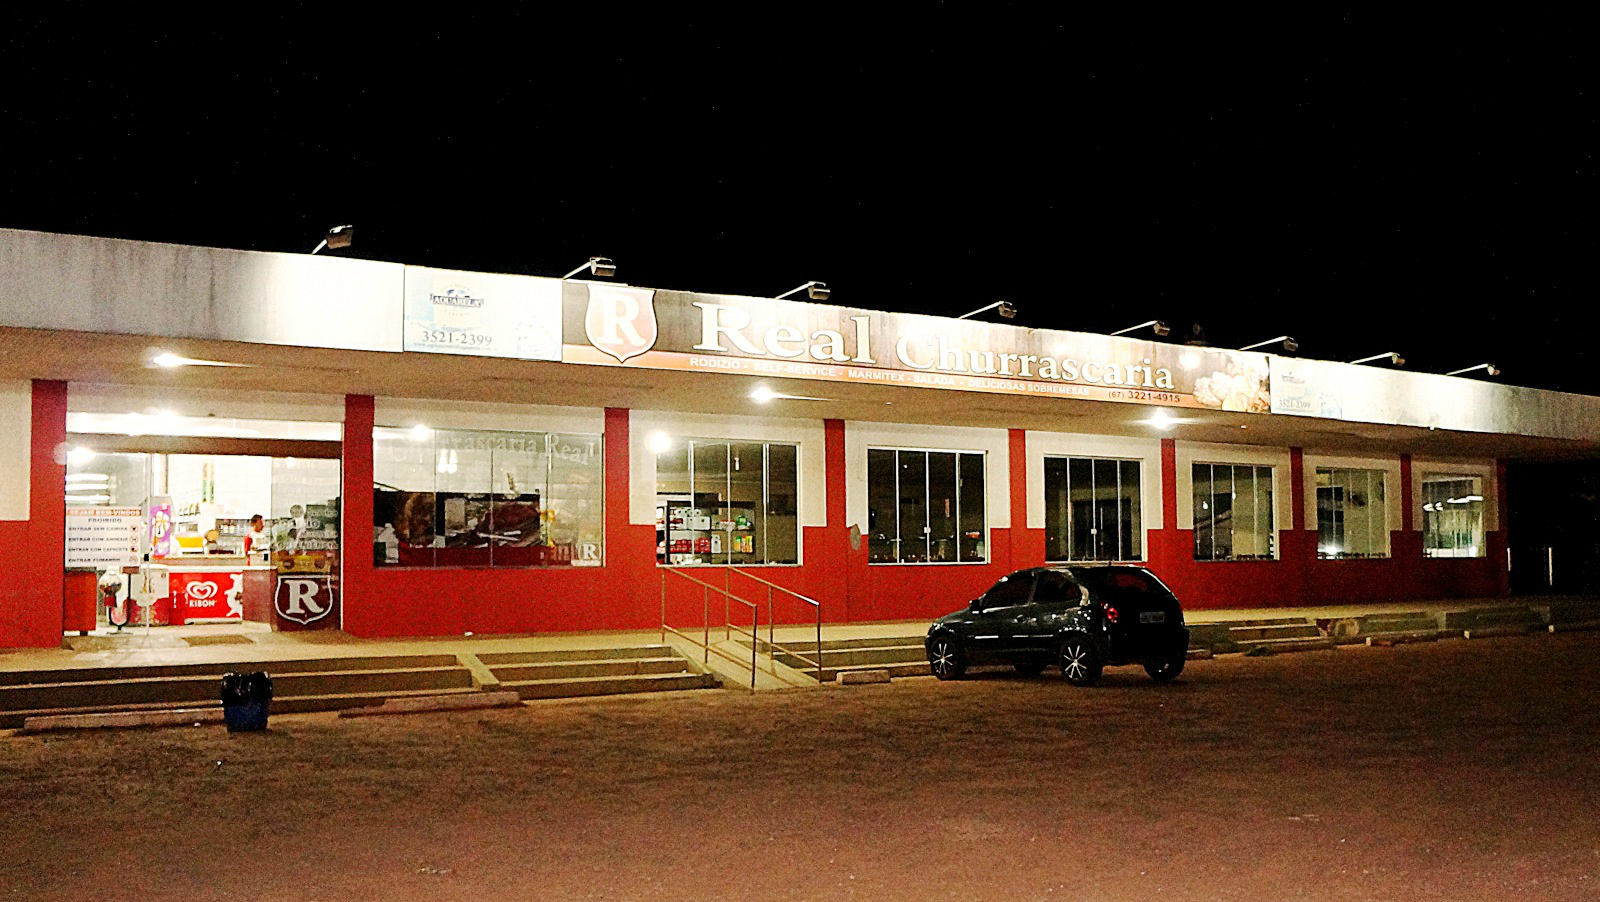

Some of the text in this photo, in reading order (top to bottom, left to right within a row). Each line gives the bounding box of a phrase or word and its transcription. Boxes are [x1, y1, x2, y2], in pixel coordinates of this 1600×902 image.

[421, 330, 493, 346] 3521-2399
[596, 293, 647, 348] R
[692, 301, 1175, 390] Real Churrascaria
[689, 357, 741, 370] RODIZIO
[754, 361, 837, 377] SELF-SERVICE
[848, 369, 905, 382] MARMITEX
[913, 375, 956, 386] SALADA
[968, 380, 1026, 392] DELICIOSAS
[1027, 383, 1090, 396] SOBREMESAS
[1108, 390, 1181, 403] (67) 3221-4915
[189, 599, 215, 608] KIBON
[284, 579, 325, 615] R
